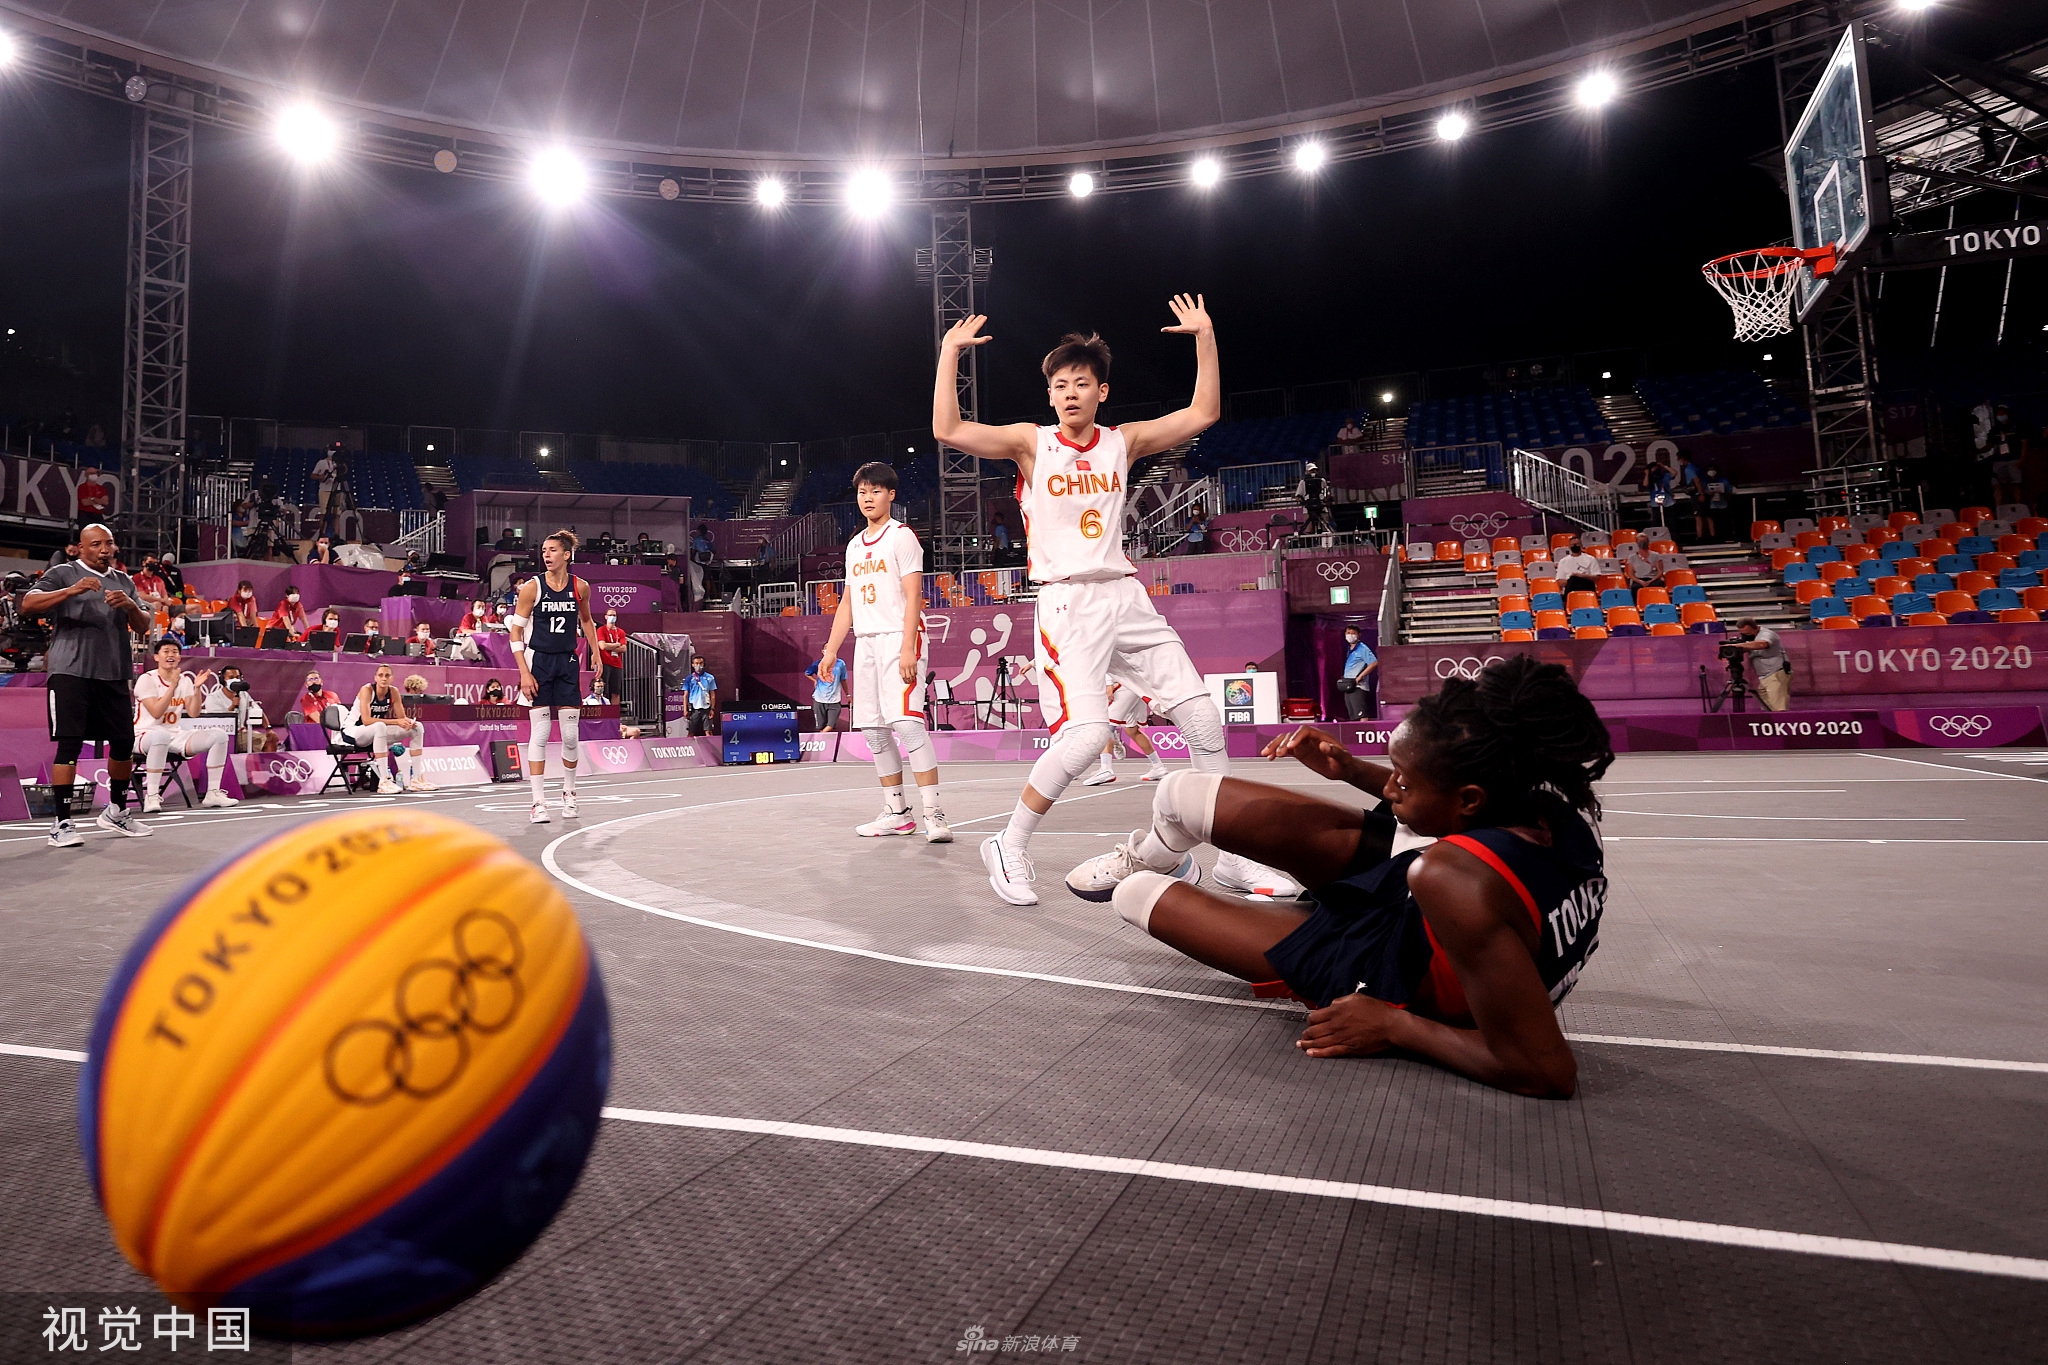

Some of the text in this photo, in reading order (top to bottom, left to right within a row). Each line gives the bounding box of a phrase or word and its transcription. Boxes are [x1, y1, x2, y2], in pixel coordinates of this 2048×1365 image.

[1944, 225, 2041, 256] TOKYO
[1047, 471, 1123, 497] CHINA
[1080, 508, 1104, 539] 6
[852, 558, 888, 577] CHINA
[620, 586, 638, 594] 2020
[860, 583, 877, 605] 13
[541, 601, 576, 612] FRANCE
[549, 616, 566, 634] 12
[1833, 644, 2033, 674] TOKYO 2020
[444, 683, 484, 703] TOKY
[162, 711, 178, 725] 10
[1228, 711, 1251, 723] FIBA
[729, 728, 792, 745] 4 3
[1748, 720, 1863, 737] TOKYO 2020
[651, 745, 695, 758] TOKYO 2020
[799, 740, 826, 752] 2020
[448, 757, 476, 771] 2020
[507, 743, 521, 769] 9
[144, 872, 311, 1051] TOKYO
